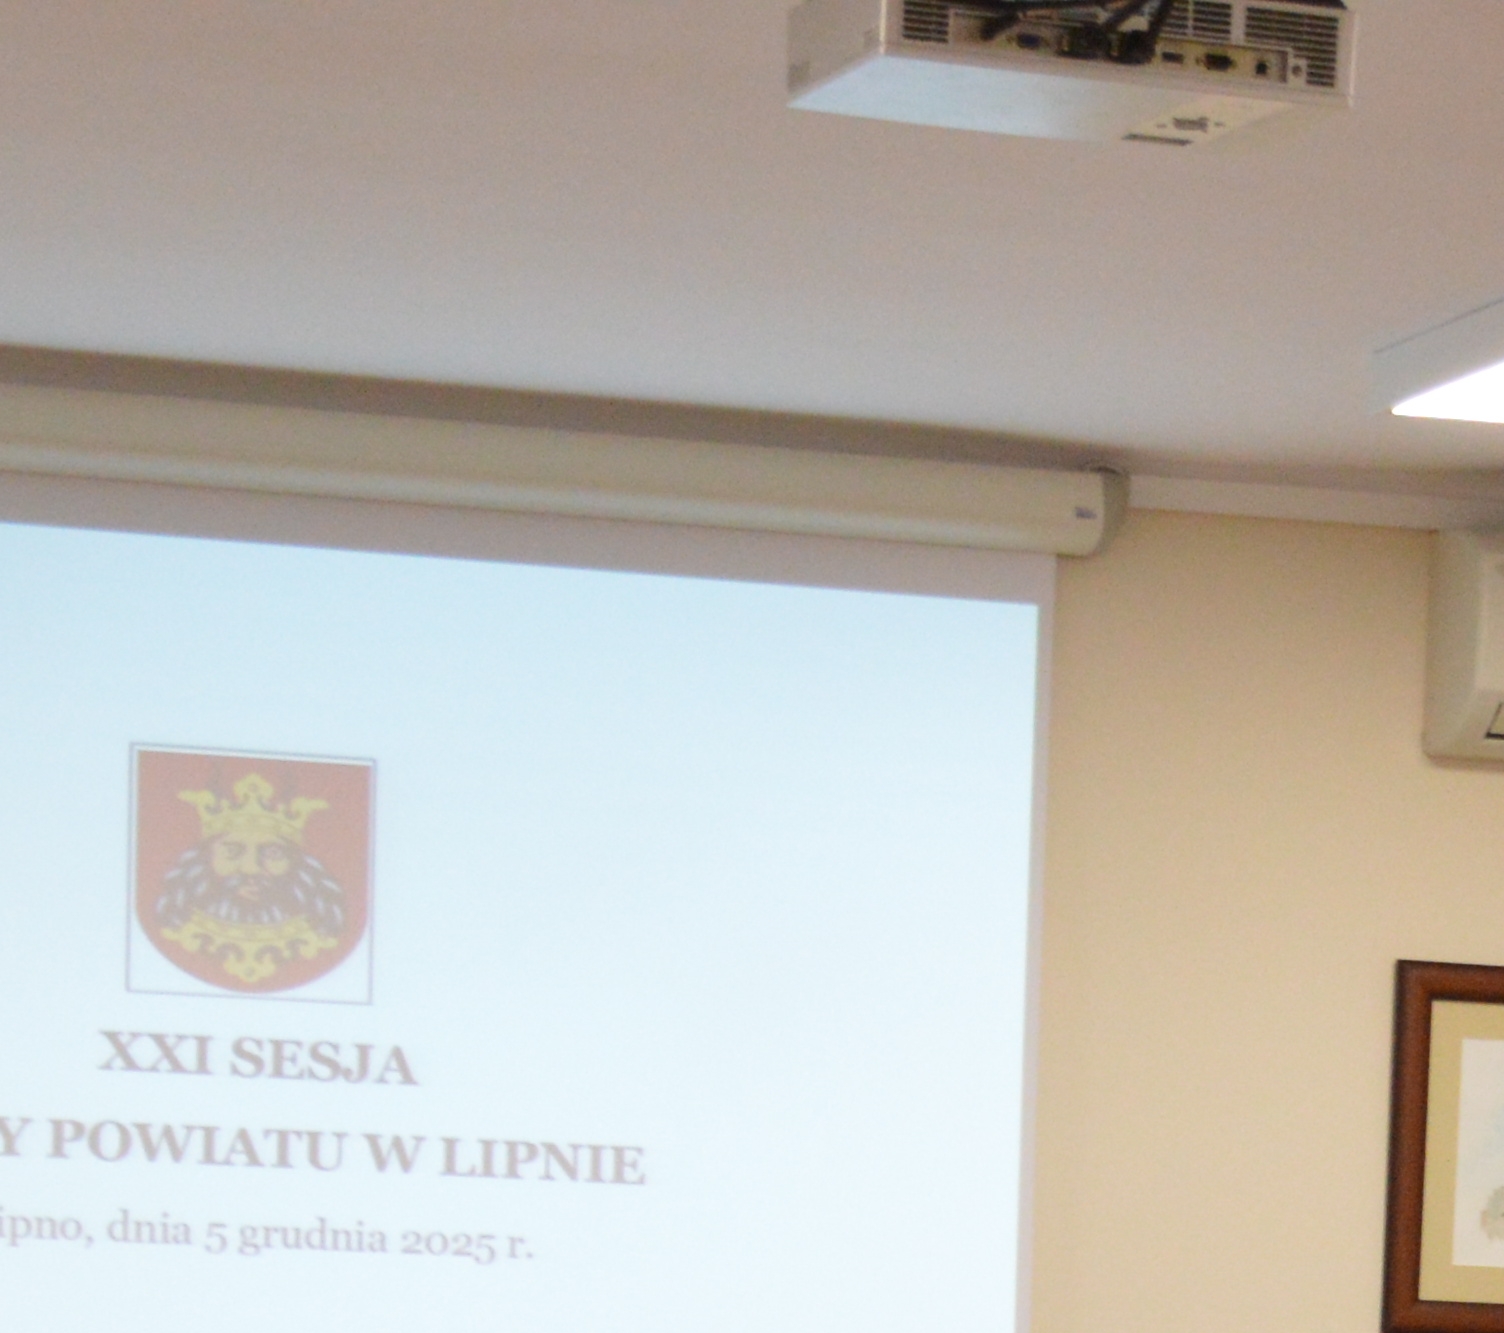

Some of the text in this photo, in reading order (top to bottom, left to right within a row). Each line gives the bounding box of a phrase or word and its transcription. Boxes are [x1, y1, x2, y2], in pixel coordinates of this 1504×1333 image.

[98, 1029, 420, 1087] XXI SESJA
[47, 1117, 348, 1172] POWIATU
[363, 1132, 427, 1175] W
[439, 1135, 647, 1187] LIPNIE
[106, 1208, 193, 1246] dnia
[204, 1221, 229, 1255] 5
[237, 1216, 387, 1257] grudnia
[400, 1229, 497, 1265] 2025
[507, 1233, 535, 1260] r.
